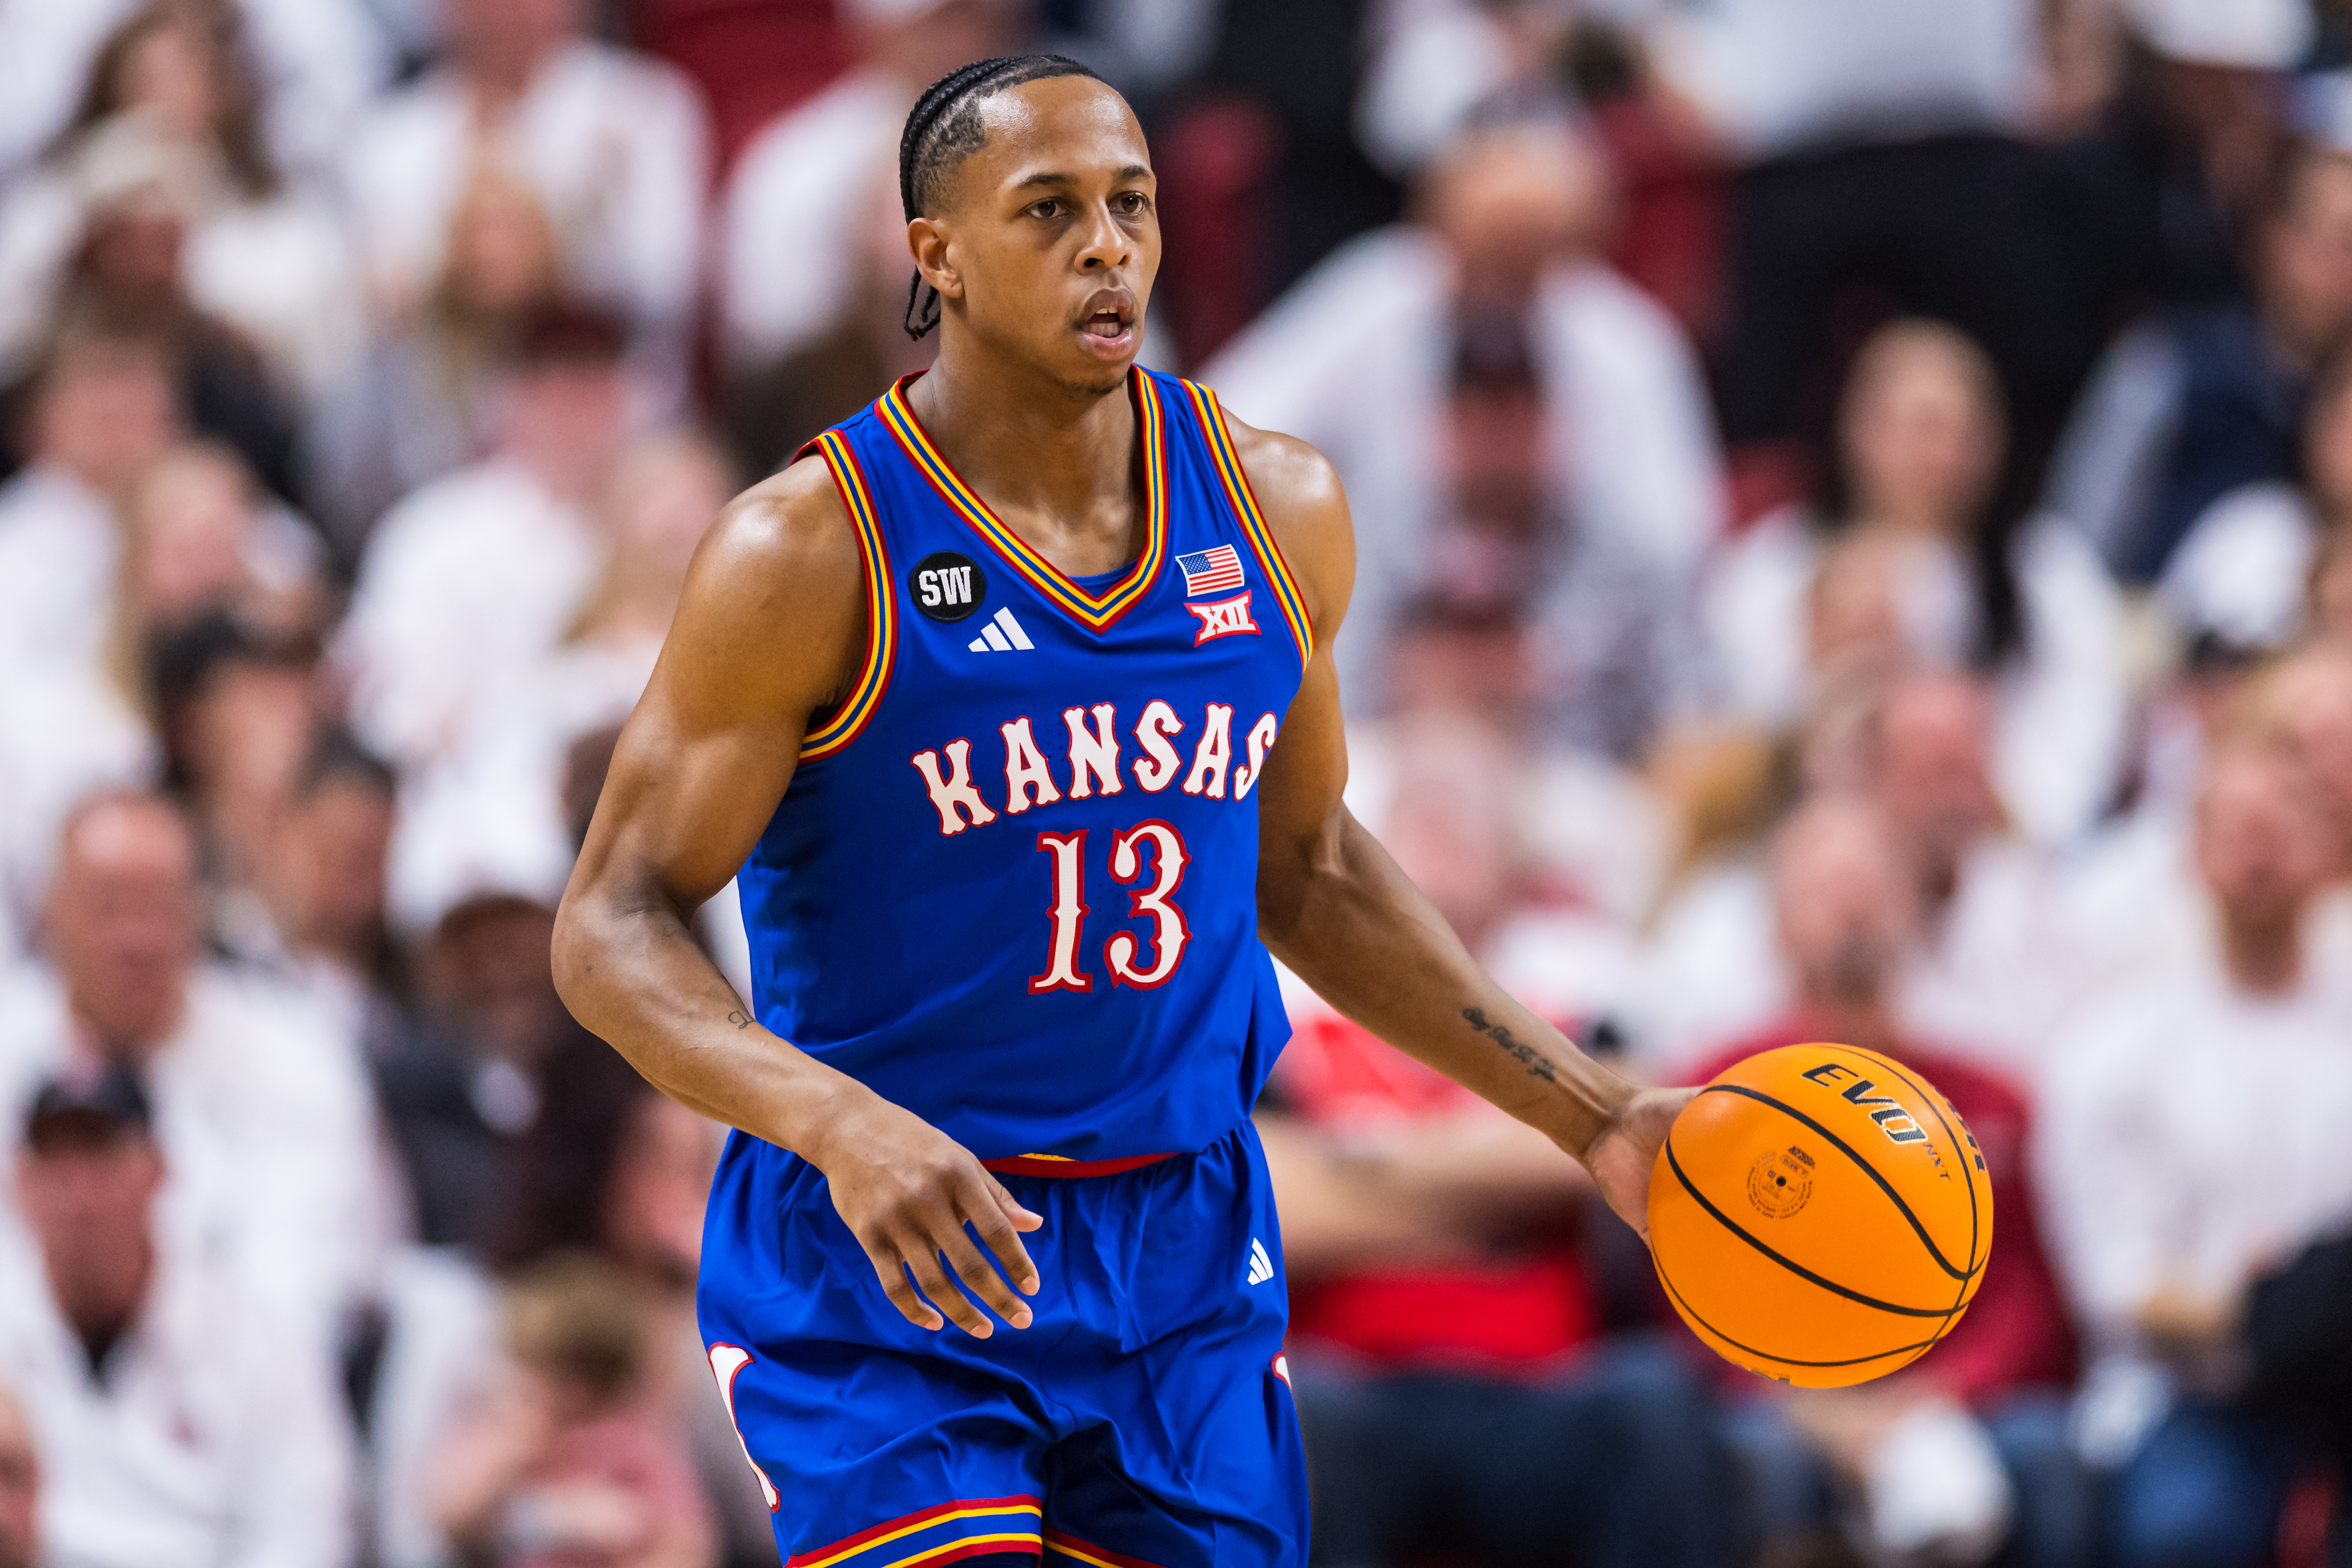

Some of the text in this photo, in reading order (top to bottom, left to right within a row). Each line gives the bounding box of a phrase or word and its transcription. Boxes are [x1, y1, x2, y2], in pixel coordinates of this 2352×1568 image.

[918, 566, 972, 607] SW
[1187, 592, 1259, 644] XII
[911, 699, 1277, 837] KANSAS
[1028, 818, 1193, 995] 13
[1800, 1063, 1928, 1145] EVO
[1923, 1143, 1952, 1182] NXT
